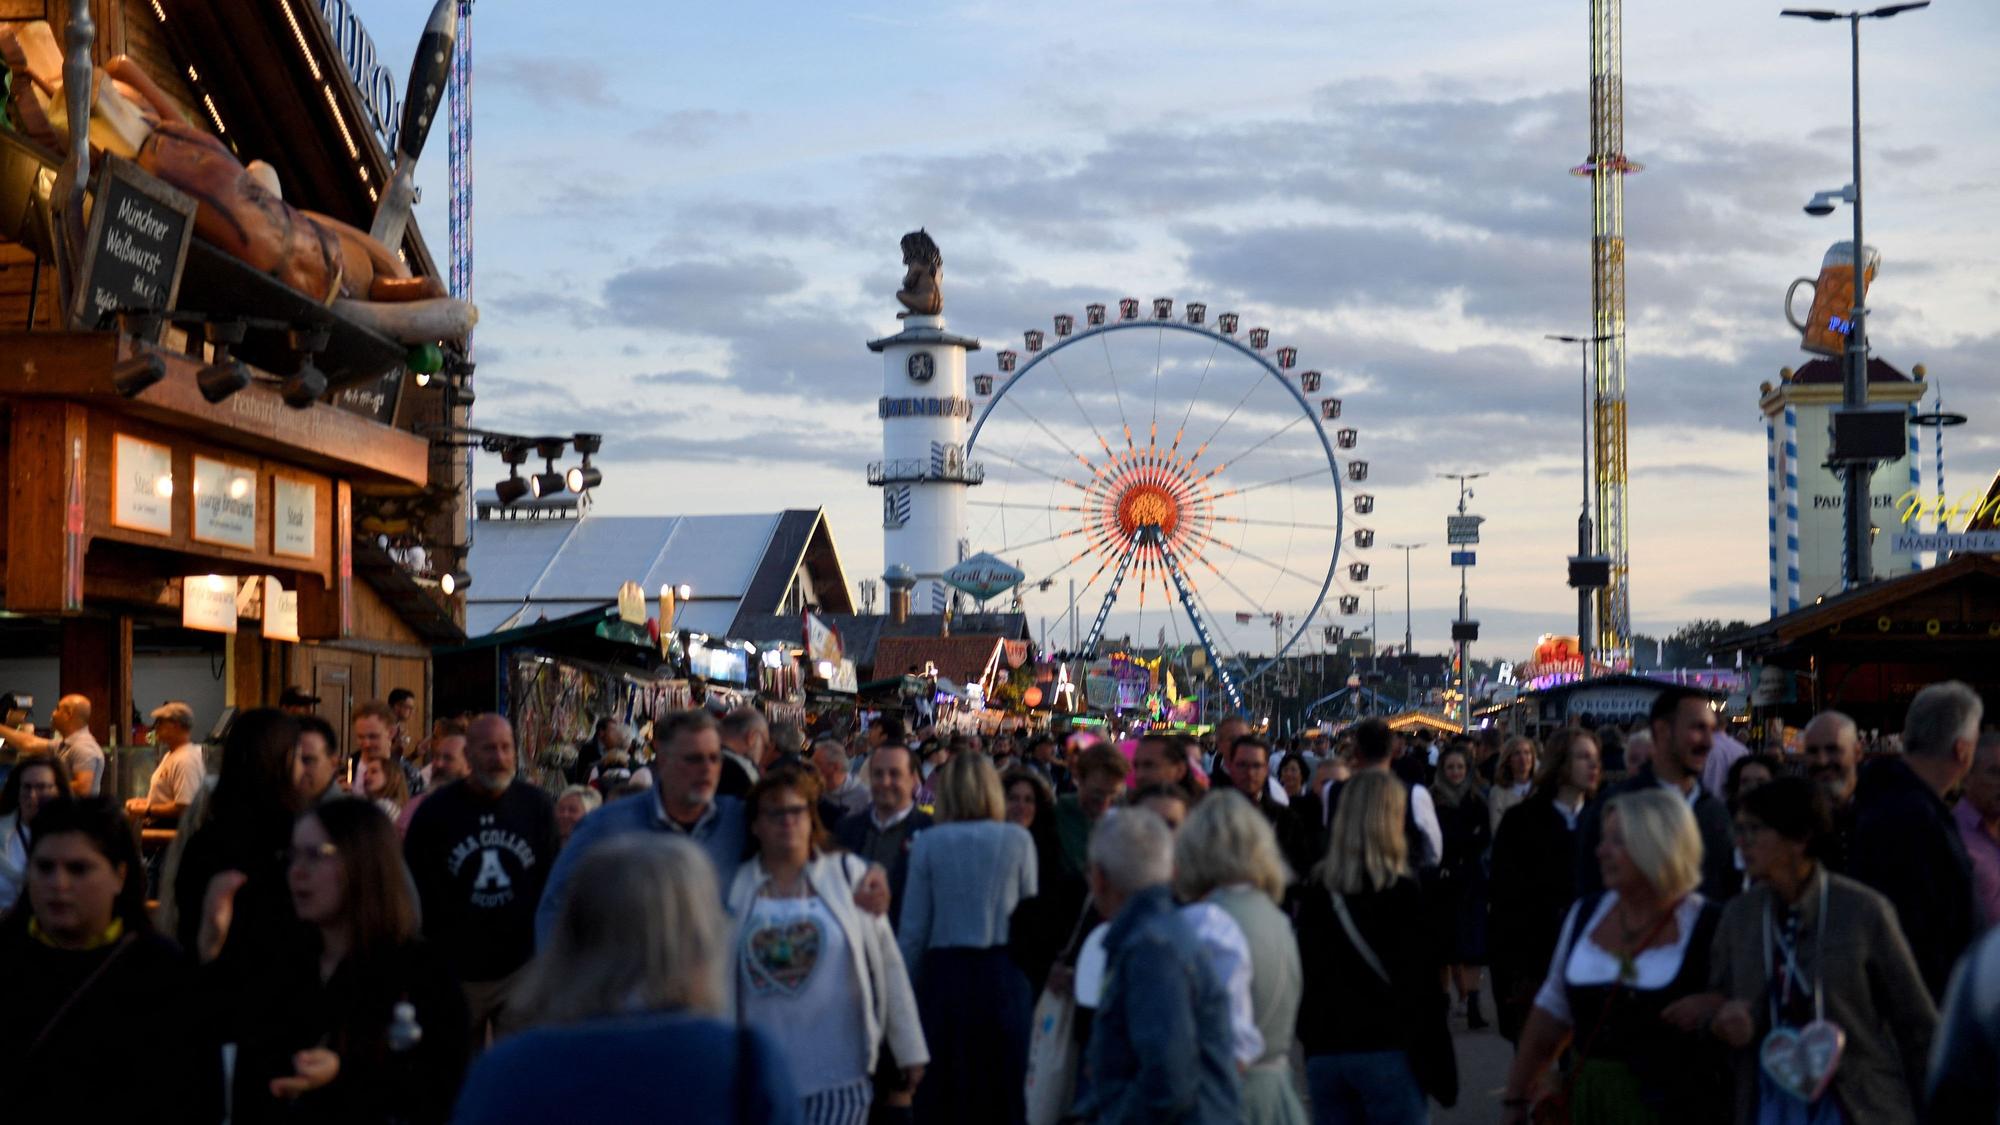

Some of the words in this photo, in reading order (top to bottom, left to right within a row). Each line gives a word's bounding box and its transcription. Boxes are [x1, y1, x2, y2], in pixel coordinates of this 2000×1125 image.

[117, 196, 169, 241] Münchner
[105, 225, 162, 275] Weißwurst
[1813, 495, 1893, 509] PAUER
[951, 568, 982, 582] Grill
[1573, 697, 1653, 711] Oktoberfe
[473, 849, 512, 889] A
